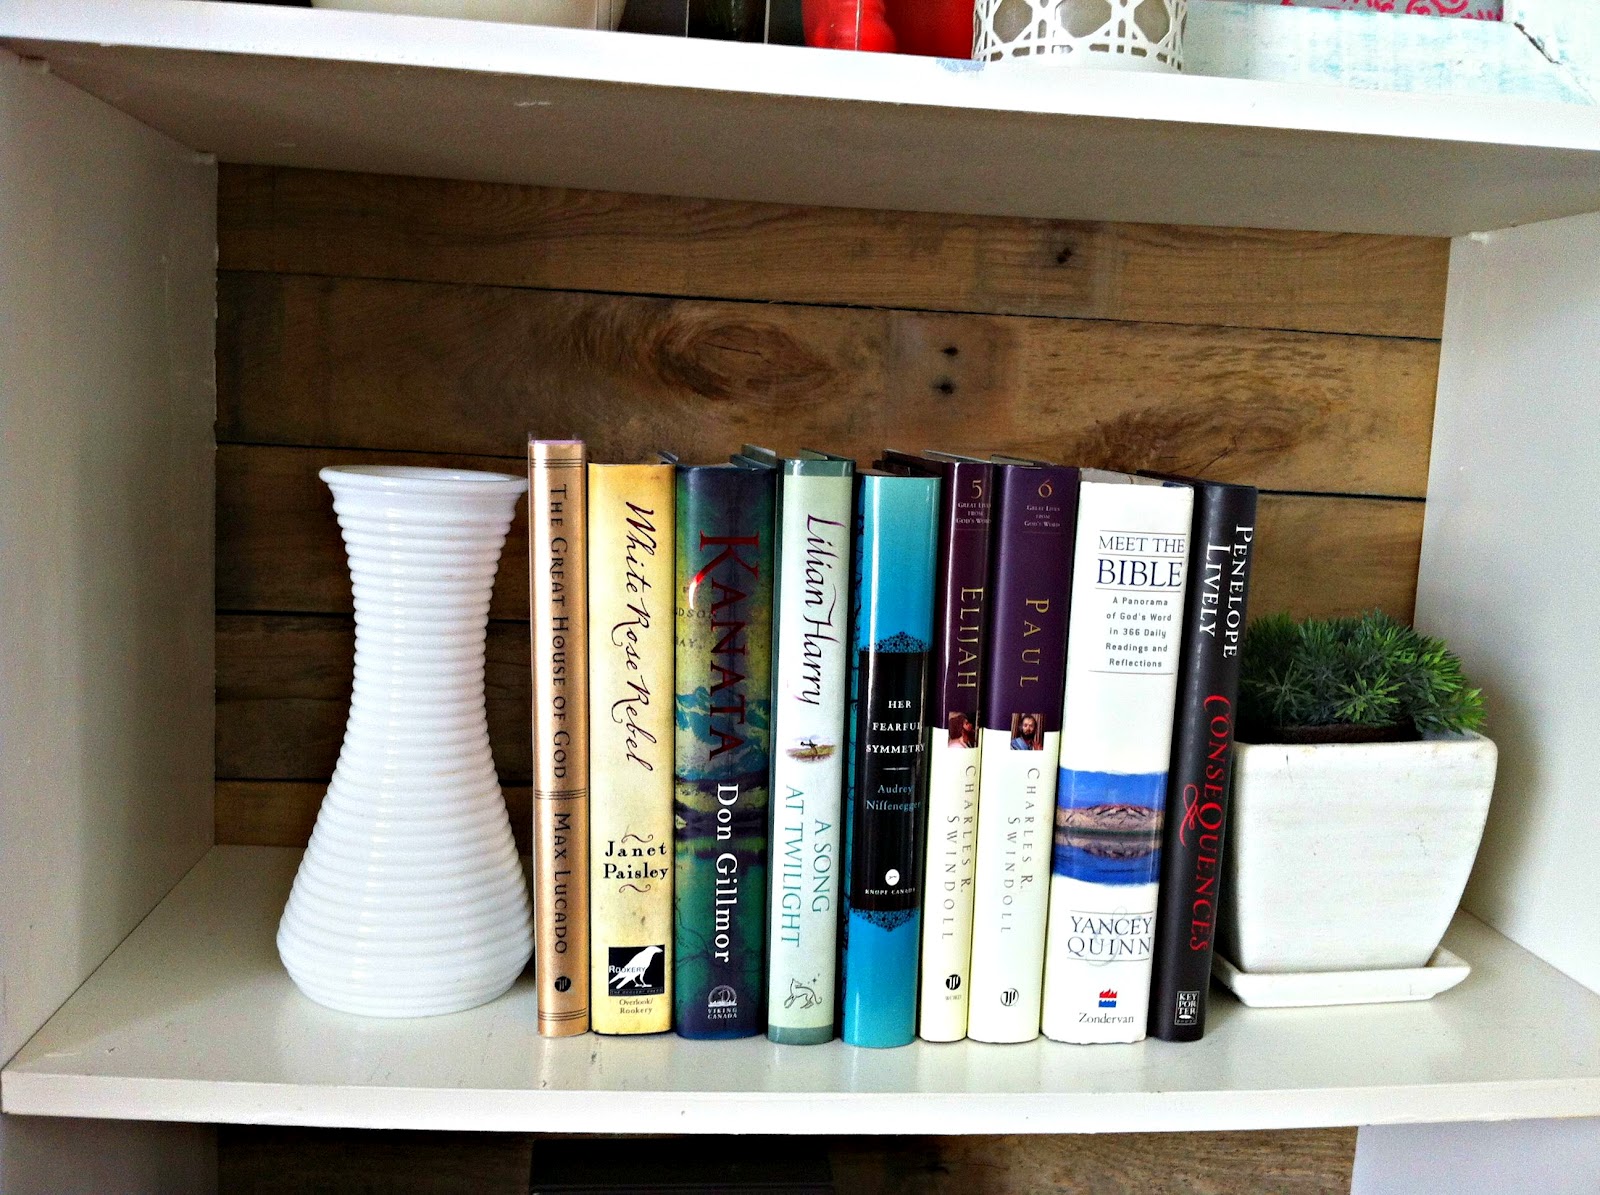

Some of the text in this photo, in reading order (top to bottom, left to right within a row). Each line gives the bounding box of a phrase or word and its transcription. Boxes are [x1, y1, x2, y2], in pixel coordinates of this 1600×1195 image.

[970, 480, 982, 500] 5
[1037, 478, 1053, 498] 6
[1099, 535, 1185, 553] MEET THE
[1096, 558, 1183, 587] BIBLE
[1112, 596, 1168, 606] A Panorama
[1200, 542, 1231, 637] LIVELY
[1222, 524, 1254, 658] PENELOPE
[794, 514, 847, 706] Lilian Harry
[1106, 612, 1172, 622] of God's Word
[550, 484, 570, 779] THE GREAT HOUSE OF GOD
[611, 501, 657, 771] White Rose Rebel
[957, 587, 984, 688] ELIJAH
[1020, 599, 1049, 688] PAUL
[1109, 627, 1167, 639] in 366 Daily
[688, 530, 760, 761] KANATA
[1105, 643, 1168, 653] Readings and
[1109, 658, 1162, 668] Reflections
[888, 700, 912, 709] HER
[872, 722, 922, 731] FEARFUL
[866, 743, 926, 753] SYMMETRY
[877, 784, 915, 795] Audrey
[960, 765, 977, 893] CHARLES R.
[1019, 767, 1041, 889] CHARLES R.
[1180, 694, 1231, 951] CONSEQUENCES
[605, 840, 667, 857] Janet
[602, 862, 669, 880] Paisley
[714, 783, 739, 963] Don Gillmor
[781, 785, 804, 948] AT TWILIGHT
[811, 819, 832, 913] A SONG
[942, 815, 960, 939] SWINDOLL
[1000, 816, 1021, 933] SWINDOLL
[554, 812, 571, 955] MAX LUCADO
[1071, 916, 1153, 935] YANCEY
[1067, 936, 1152, 957] QUINN
[1078, 1012, 1135, 1024] Zondervan
[1177, 1007, 1196, 1015] TER
